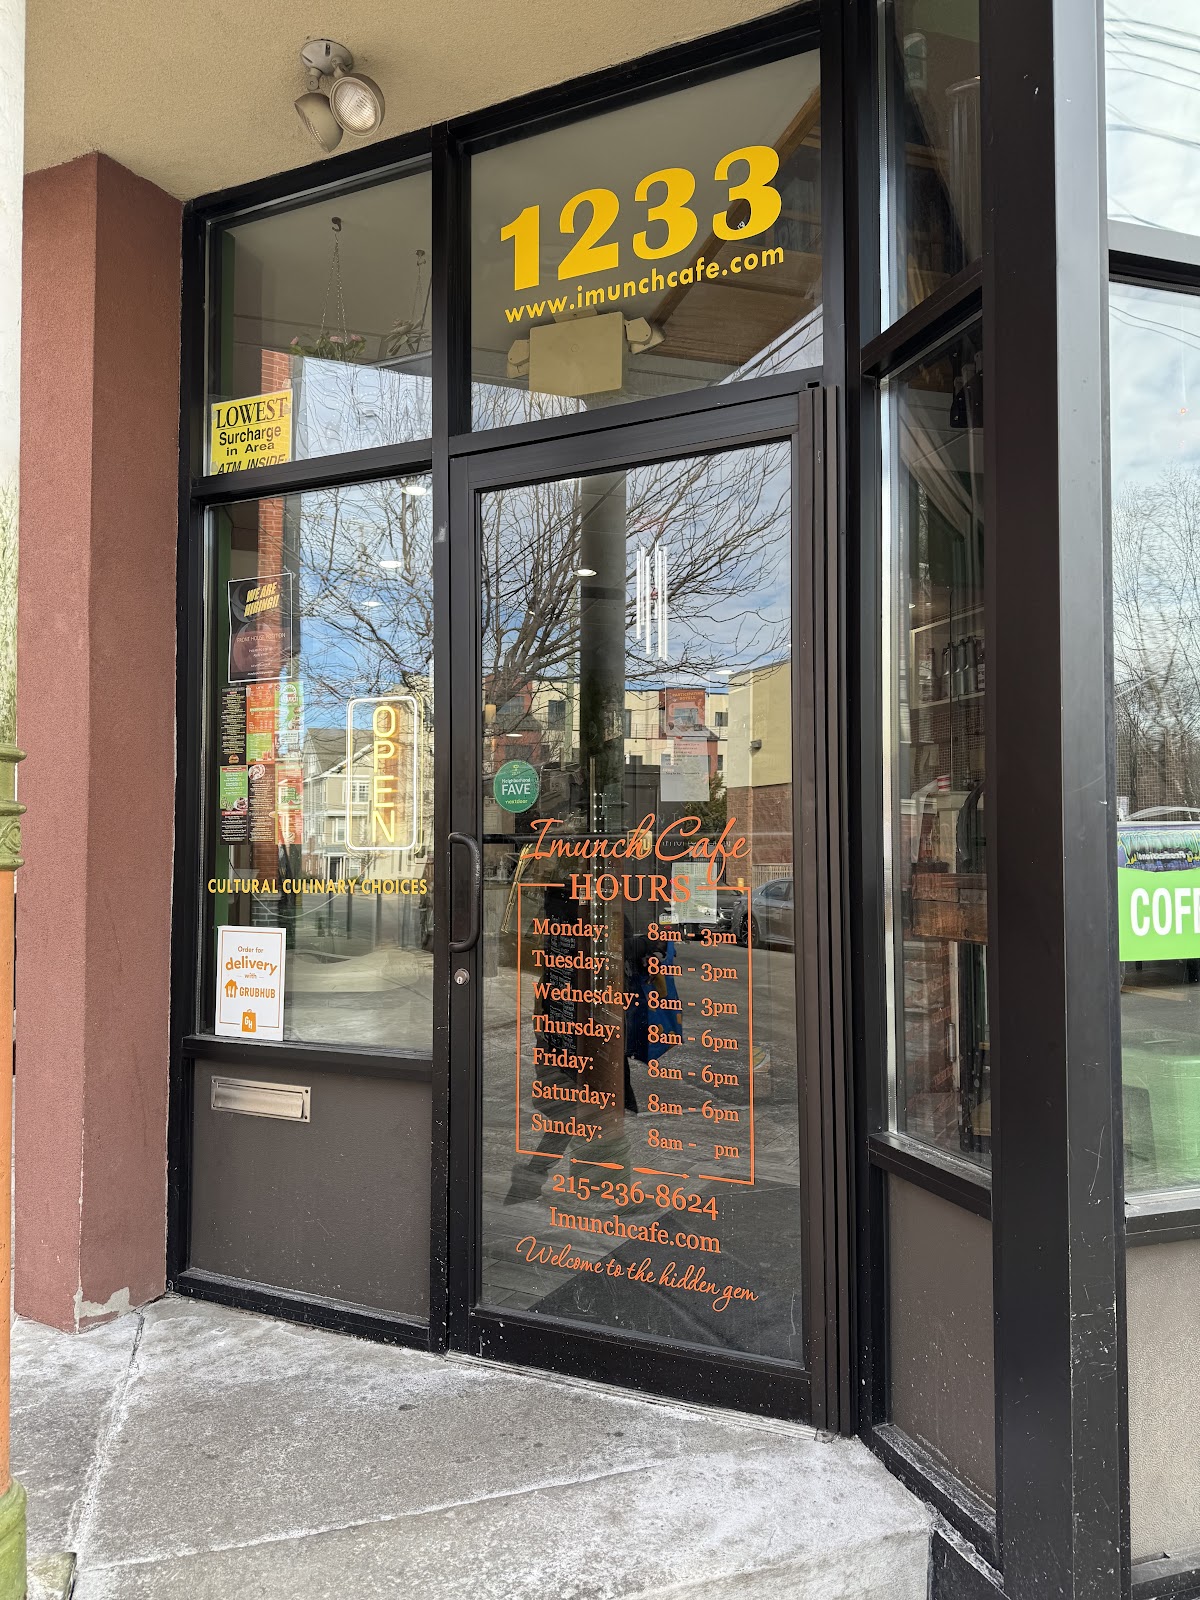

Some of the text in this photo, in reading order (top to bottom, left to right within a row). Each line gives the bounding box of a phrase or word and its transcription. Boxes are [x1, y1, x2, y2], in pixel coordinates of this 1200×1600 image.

[500, 144, 784, 292] 1233
[503, 245, 786, 324] www.imunchcafe.com
[216, 397, 288, 429] LOWEST
[219, 425, 282, 446] Surcharge
[226, 442, 275, 457] in Area
[218, 461, 243, 475] ATM
[246, 581, 278, 603] WE ARE
[372, 705, 396, 843] OPEN
[501, 783, 531, 796] FAVE
[519, 813, 657, 861] Imunch
[654, 815, 752, 886] Cafe
[207, 878, 428, 895] CULTURAL CULINARY CHOICES
[569, 873, 691, 903] HOURS
[1131, 888, 1200, 936] COF
[532, 918, 609, 941] Monday:
[647, 923, 682, 942] 8am
[700, 929, 737, 947] 3pm
[225, 956, 278, 976] delivery
[237, 945, 264, 954] Order for
[531, 949, 609, 975] Tuesday:
[647, 957, 683, 976] 8am
[700, 963, 737, 982] 3pm
[239, 984, 276, 999] GRUBHUB
[244, 972, 258, 980] with
[531, 981, 639, 1011] Wednesday:
[647, 991, 682, 1010] 8am
[700, 997, 737, 1017] 3pm
[531, 1014, 621, 1043] Thursday:
[647, 1025, 682, 1045] 8am
[701, 1029, 738, 1053] 6pm
[532, 1047, 593, 1074] Friday:
[647, 1059, 683, 1080] 8am
[701, 1065, 738, 1088] 6pm
[531, 1080, 616, 1110] Saturday:
[647, 1093, 683, 1116] 8am
[701, 1100, 739, 1124] 6pm
[531, 1113, 603, 1143] Sunday:
[647, 1129, 683, 1151] 8am
[714, 1145, 739, 1160] pm
[552, 1174, 719, 1221] 215-236-8624
[549, 1206, 721, 1254] Imunchcafe.com
[515, 1235, 759, 1313] Welcome to the hidden gem
